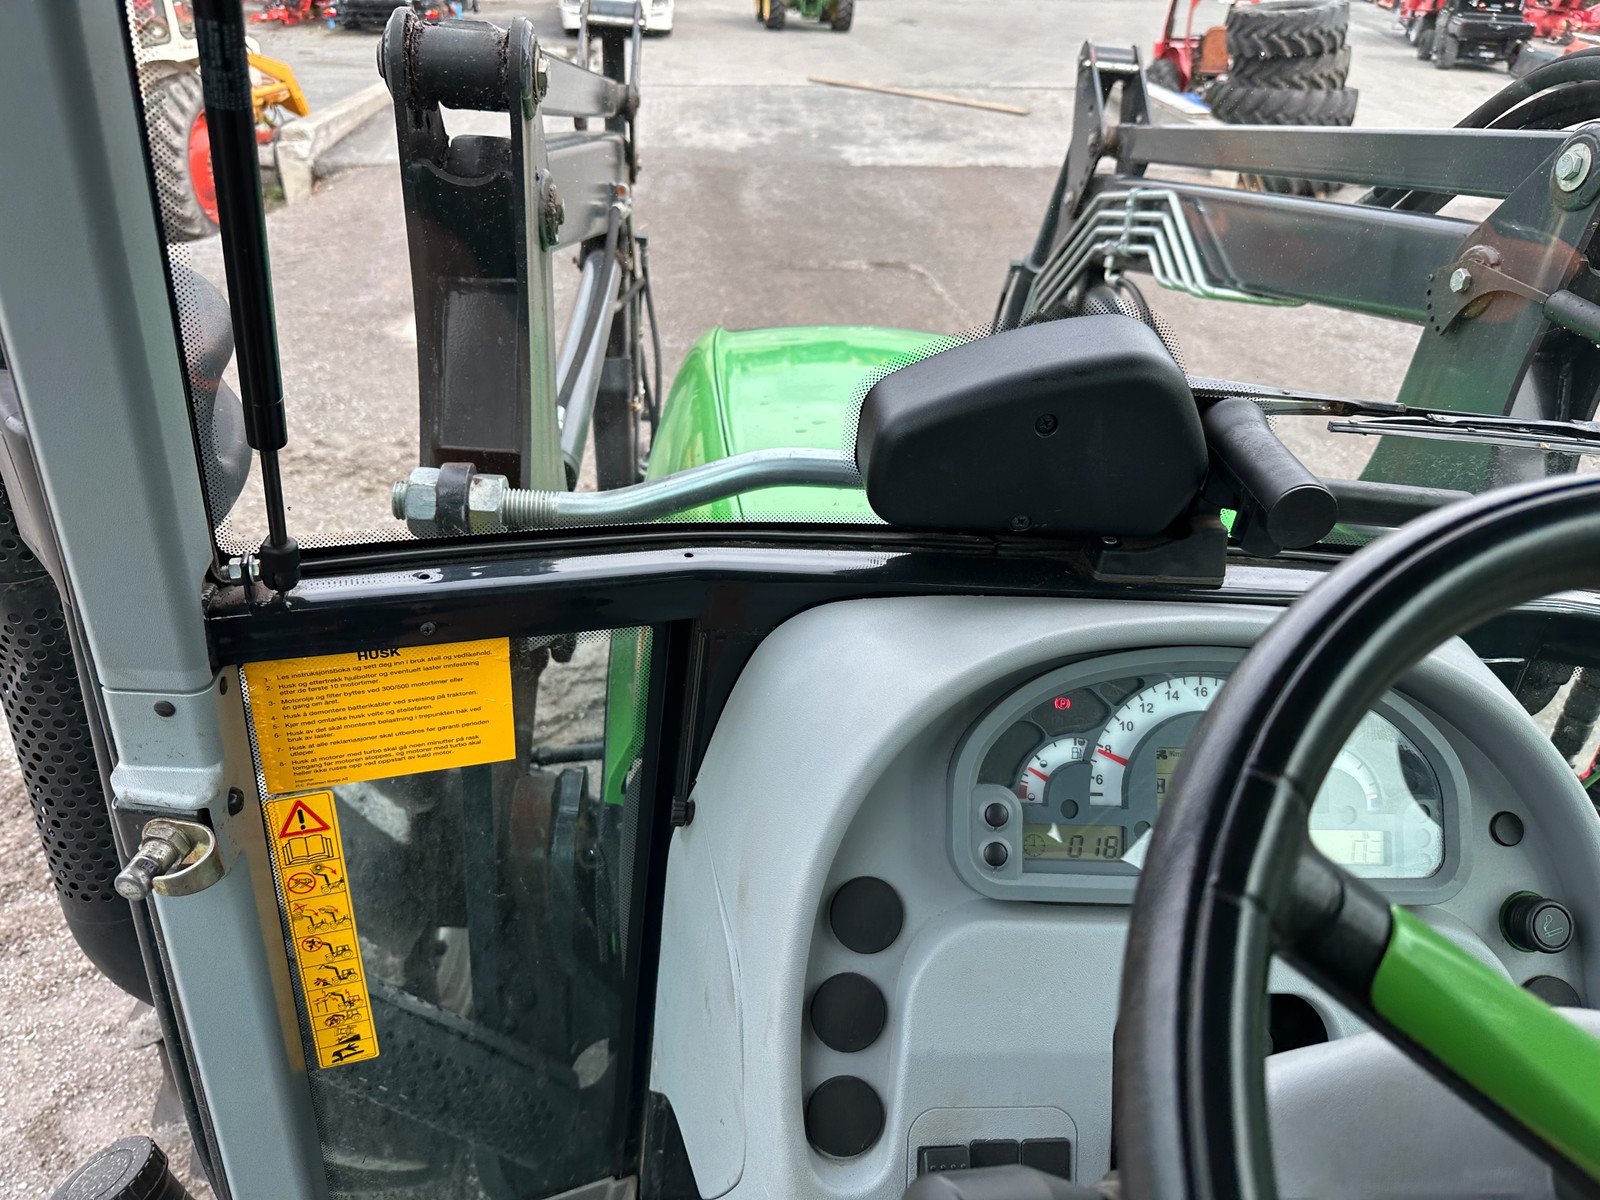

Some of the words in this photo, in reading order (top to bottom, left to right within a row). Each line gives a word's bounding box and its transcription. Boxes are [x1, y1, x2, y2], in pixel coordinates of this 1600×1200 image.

[358, 648, 401, 660] HUSK
[382, 683, 409, 691] 300/500
[411, 679, 448, 687] motortimer
[1165, 690, 1179, 701] 14
[1193, 686, 1208, 697] 16
[308, 708, 346, 716] demontere
[1139, 702, 1154, 713] 12
[1119, 721, 1134, 731] 10
[1095, 774, 1103, 785] 6
